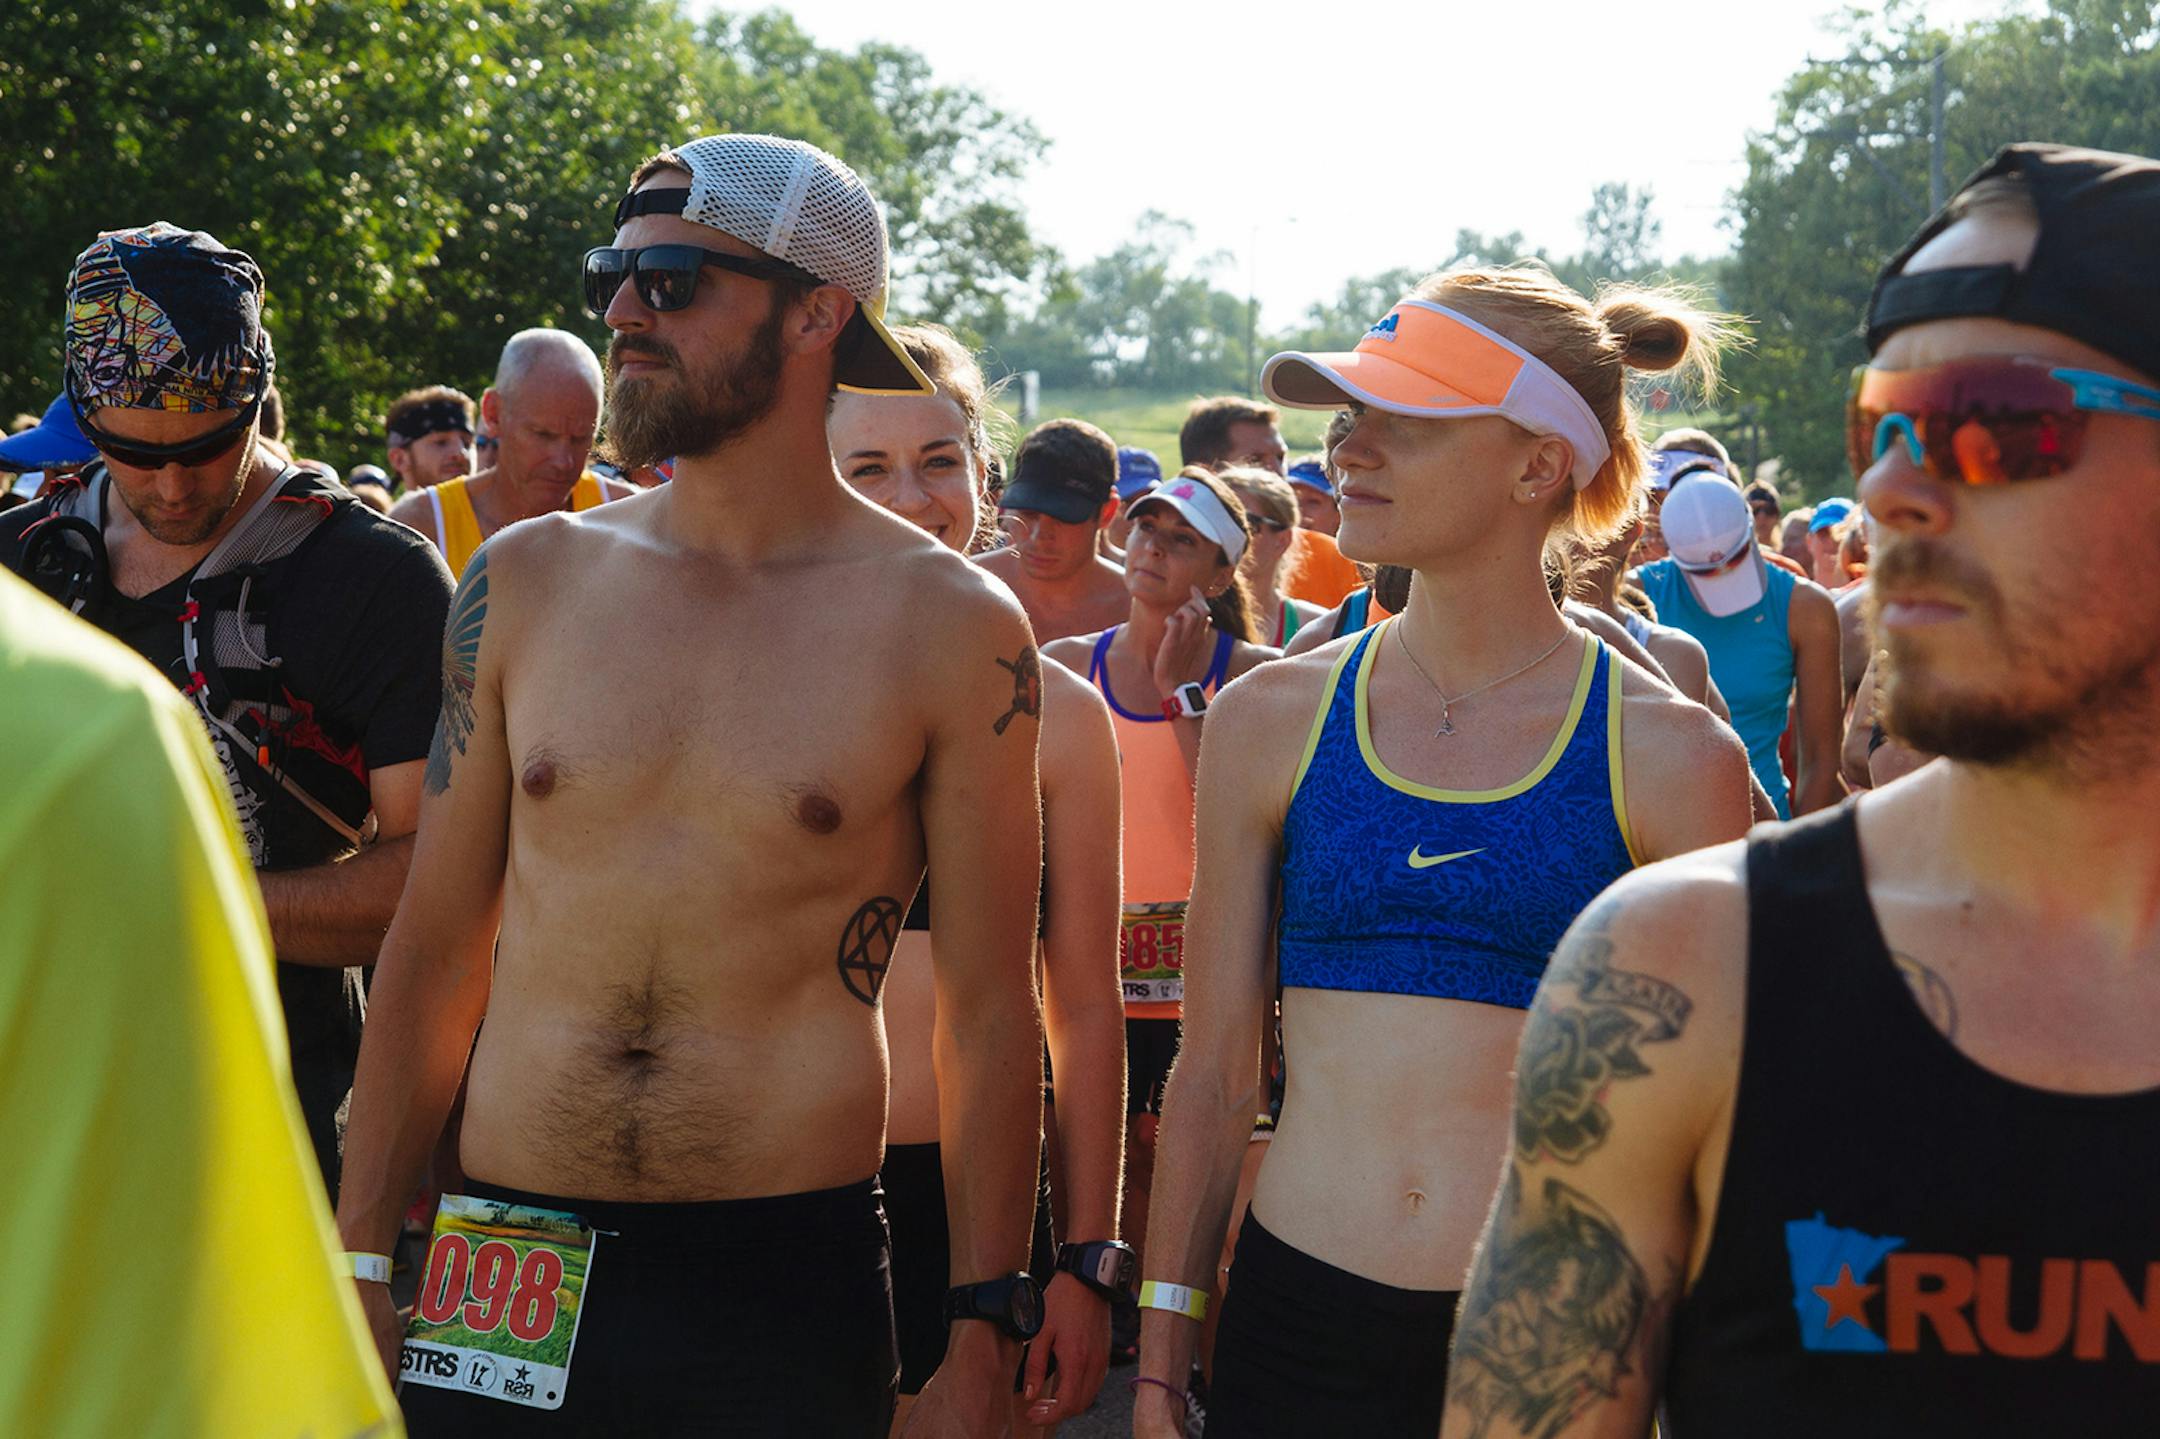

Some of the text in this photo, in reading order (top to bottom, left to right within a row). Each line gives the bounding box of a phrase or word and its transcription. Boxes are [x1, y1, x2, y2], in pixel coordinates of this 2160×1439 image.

[1121, 923, 1184, 971] 85
[411, 1234, 563, 1342] 098
[1886, 1253, 2160, 1362] RUN
